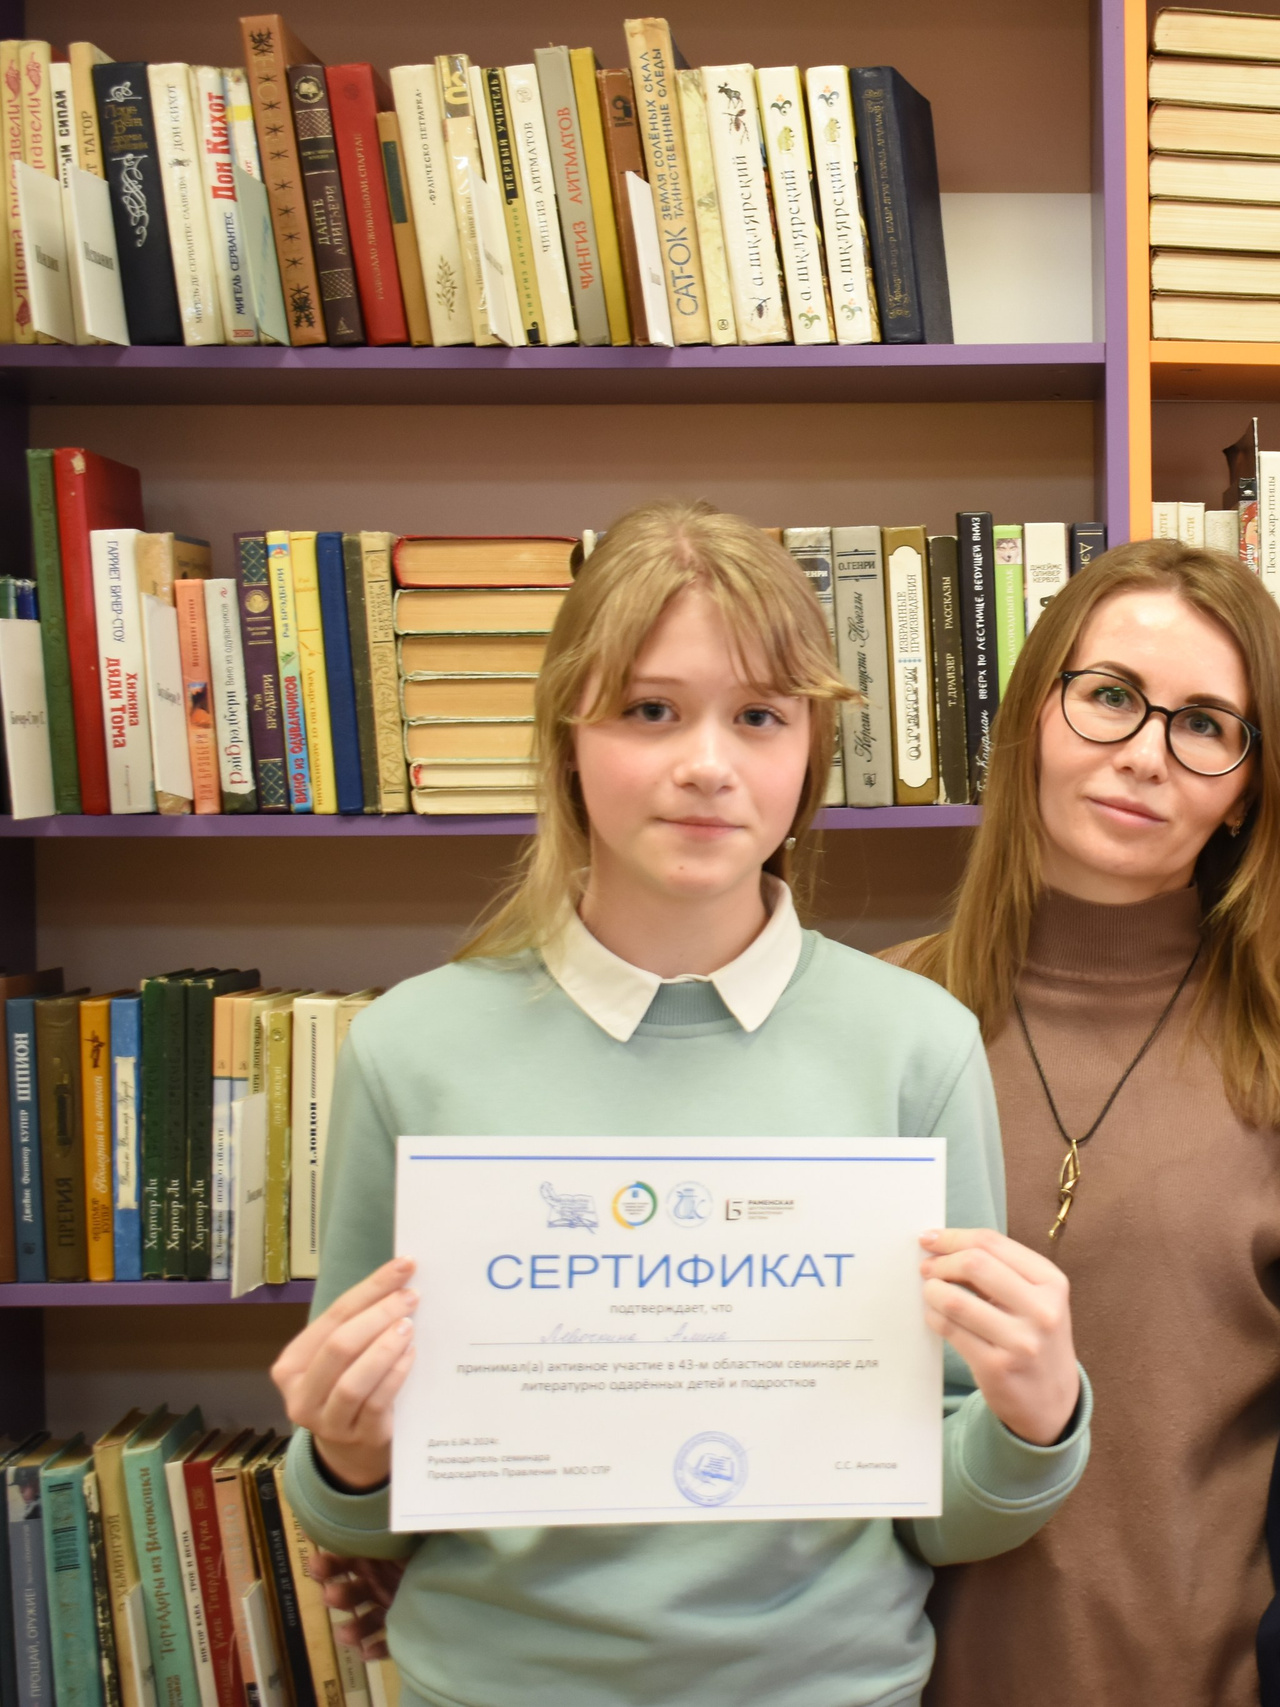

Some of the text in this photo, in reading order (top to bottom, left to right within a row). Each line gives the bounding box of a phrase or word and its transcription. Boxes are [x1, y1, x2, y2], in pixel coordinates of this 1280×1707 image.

[206, 92, 237, 201] Дон Кихот
[490, 78, 515, 190] ПЕРВЫЙ УЧИТЕЛЬ
[640, 51, 672, 221] ЗЕМЛЯ СОЛЁНЫХ СКАЛ
[557, 107, 594, 289] ЧИНГИЗ АЙТМАТОВ
[223, 212, 247, 316] МИГЕЛЬ СЕРВАНТЕС
[664, 227, 699, 315] САТ-ОК
[107, 541, 125, 643] ГАРРИЕТ БИЧЕР-СТОУ
[838, 560, 876, 572] О.ГЕНРИ
[898, 592, 908, 653] ИЗБРАННЫЕ
[908, 574, 920, 653] ПРОИЗВЕДЕНИЯ
[971, 517, 988, 699] ВВЕРХ ПО ЛЕСТНИЦЕ, ВЕДУЩЕЙ ВНИЗ
[943, 576, 957, 706] Т.ДРАЙЗЕР РАССКАЗЫ
[126, 672, 139, 726] Хижина
[253, 694, 263, 711] Рэй
[263, 674, 277, 729] БРЭДБЕРИ
[14, 1032, 31, 1102] ШПИОН
[20, 1109, 29, 1142] КУПЕР
[21, 1147, 31, 1184] Фенимор
[56, 1177, 75, 1247] ПРЕРИЯ
[486, 1254, 854, 1290] СЕРТИФИКАТ
[610, 1302, 732, 1316] подтверждает, что
[457, 1358, 878, 1375] принимал(а) активное участие в 43-м областном семинаре для
[521, 1376, 816, 1393] литературно одарённых детей и подростков
[428, 1439, 448, 1448] Дата
[428, 1453, 550, 1466] Руководитель семинара
[835, 1460, 897, 1470] С.С. Антипов
[428, 1465, 611, 1481] Председатель Правления МОО СПР
[27, 1588, 41, 1698] ПРОЩАЙ, ОРУЖИЕ!
